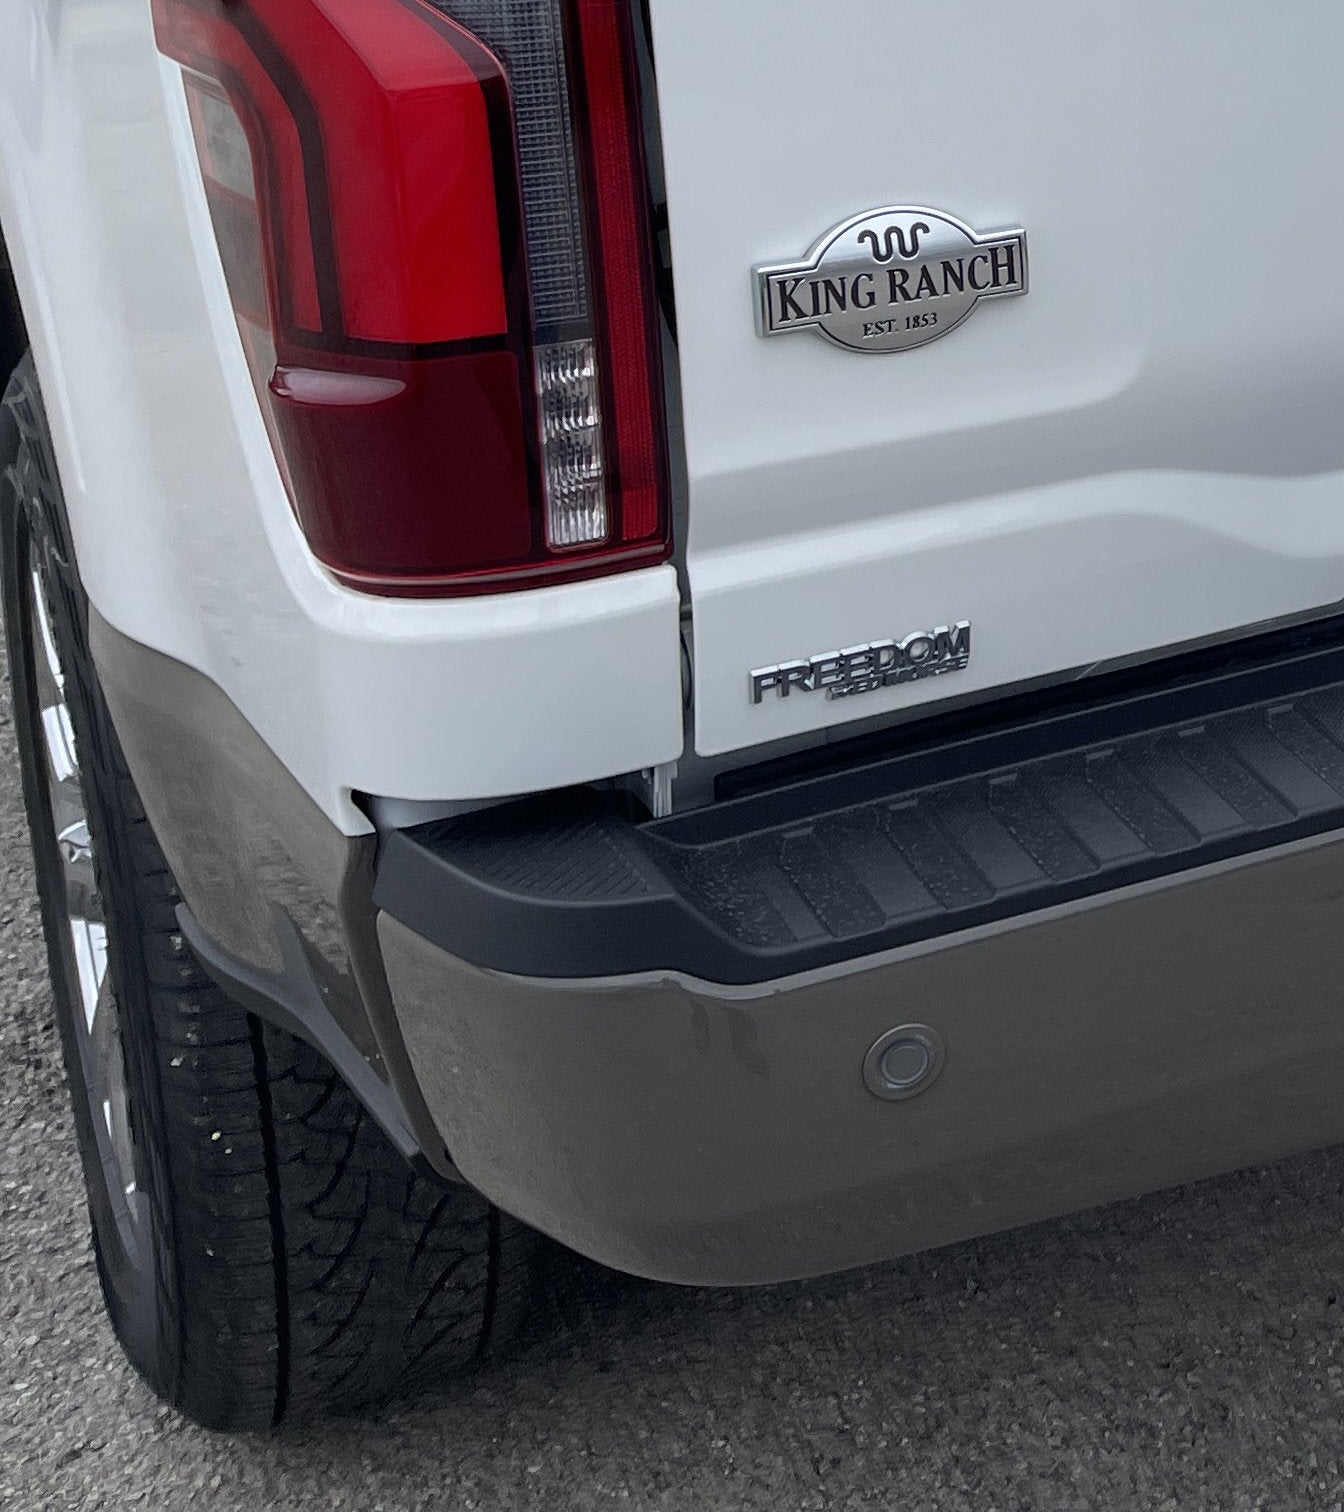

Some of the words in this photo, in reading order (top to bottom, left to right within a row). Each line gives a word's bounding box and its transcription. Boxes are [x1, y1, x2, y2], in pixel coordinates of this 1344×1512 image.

[777, 272, 875, 322] KING
[888, 244, 1017, 305] RANCH
[905, 312, 938, 331] 1853
[749, 620, 970, 704] FREEDOM
